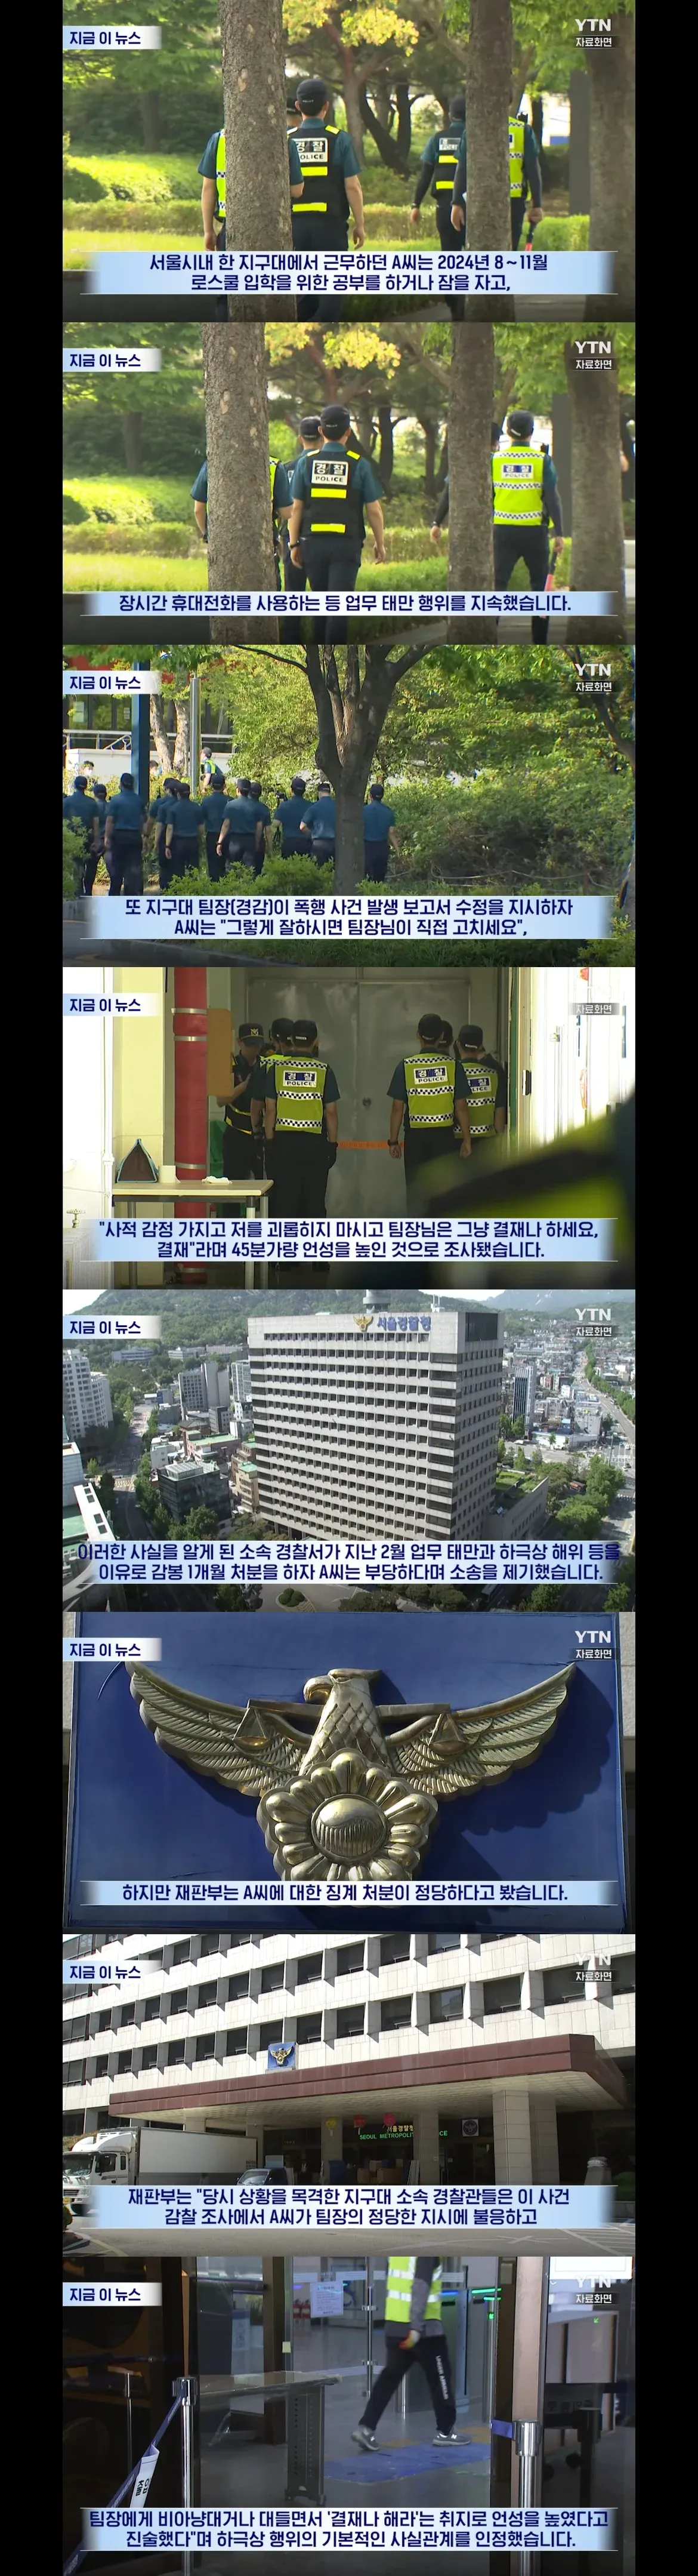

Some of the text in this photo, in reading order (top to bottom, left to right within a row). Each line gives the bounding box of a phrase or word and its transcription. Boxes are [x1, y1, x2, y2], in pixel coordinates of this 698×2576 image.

[316, 464, 344, 475] 경찰
[418, 1069, 443, 1077] 경찰
[377, 1316, 431, 1331] 서울경찰청
